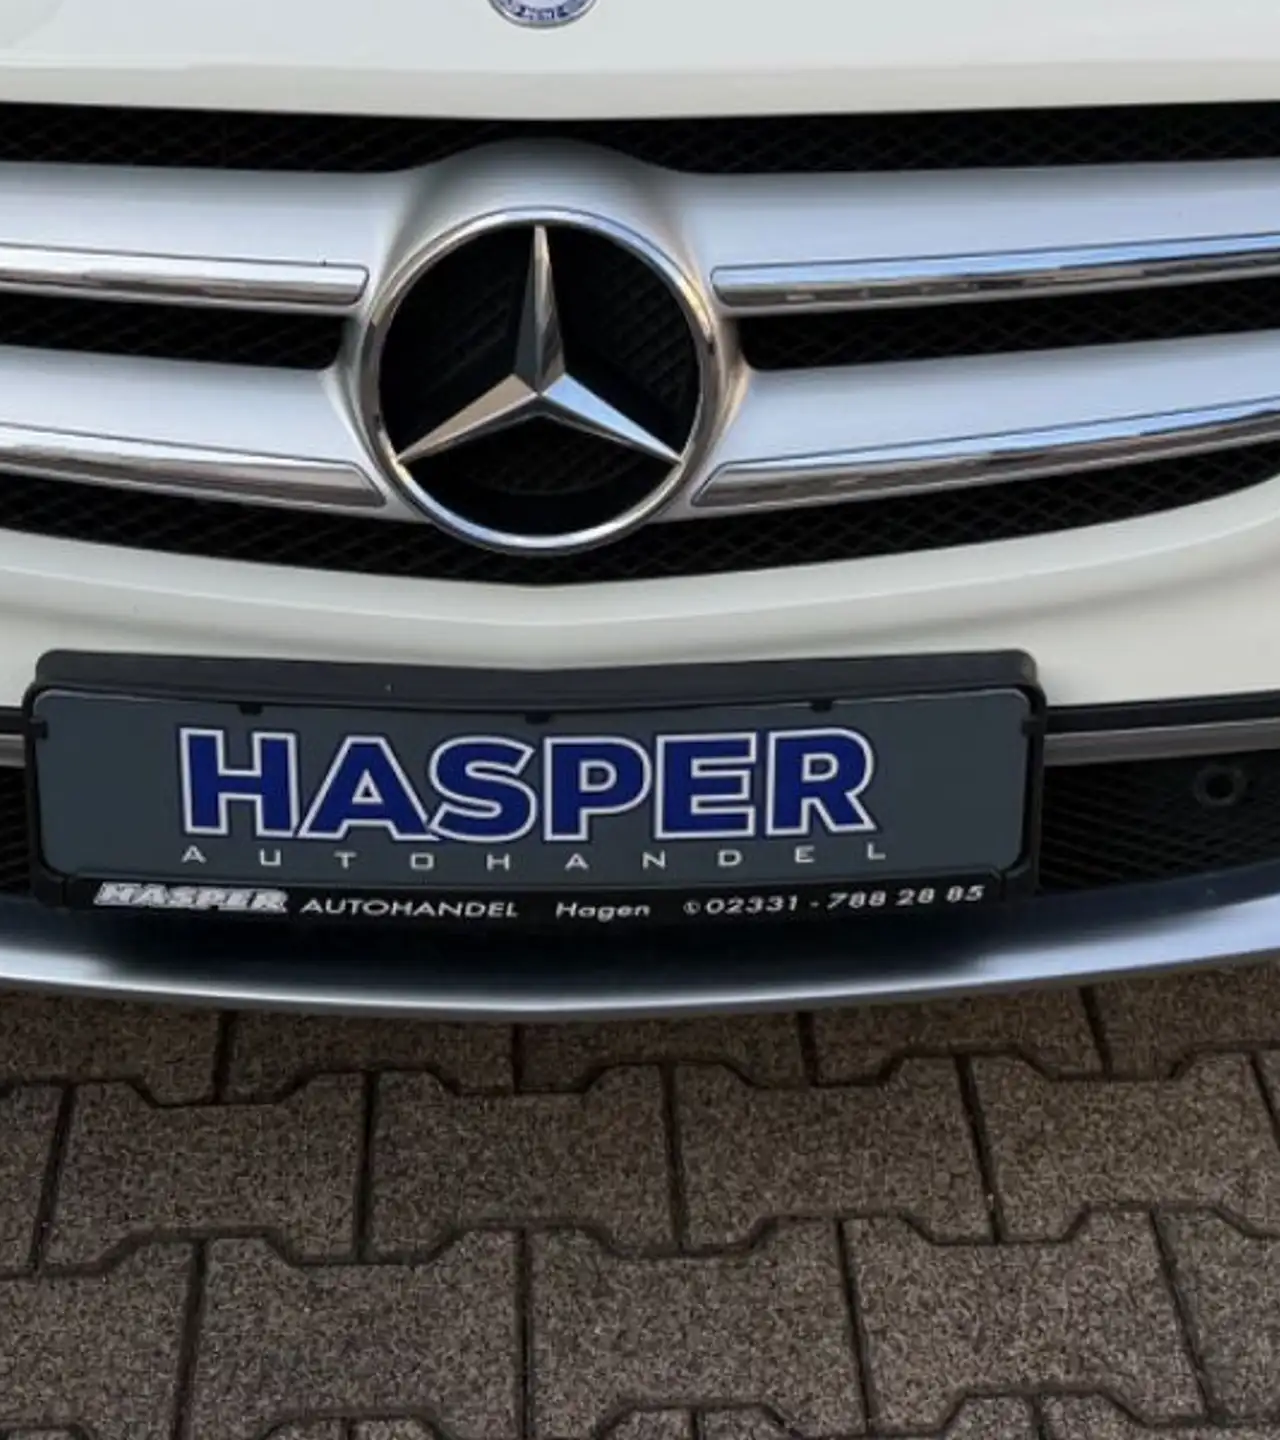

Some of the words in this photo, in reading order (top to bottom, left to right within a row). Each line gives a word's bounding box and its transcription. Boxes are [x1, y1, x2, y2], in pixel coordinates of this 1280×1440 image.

[179, 726, 878, 844] HASPER
[182, 843, 887, 871] AUTOHANDEL
[93, 881, 289, 914] HASPER
[301, 898, 519, 918] AUTOHANDEL
[555, 901, 650, 922] Hagen
[706, 895, 799, 916] 02331
